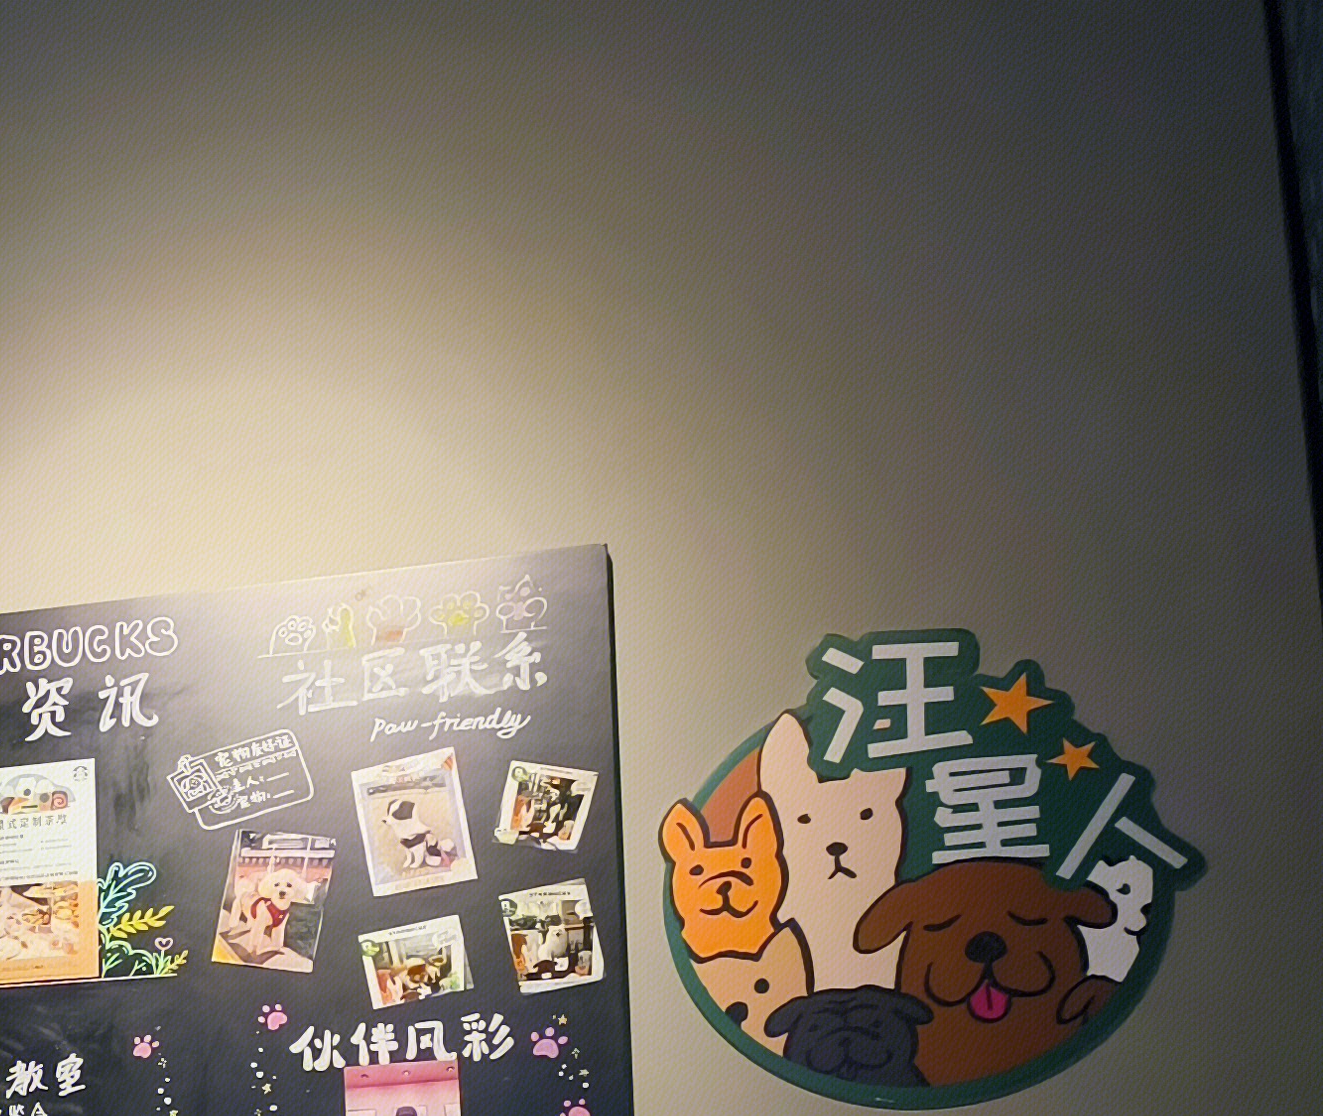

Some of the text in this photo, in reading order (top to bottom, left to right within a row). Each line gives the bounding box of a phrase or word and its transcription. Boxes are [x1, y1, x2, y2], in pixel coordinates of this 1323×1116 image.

[276, 632, 548, 715] 社区联系
[369, 708, 531, 742] Paw-friendly
[289, 1012, 515, 1072] 伙伴风彩
